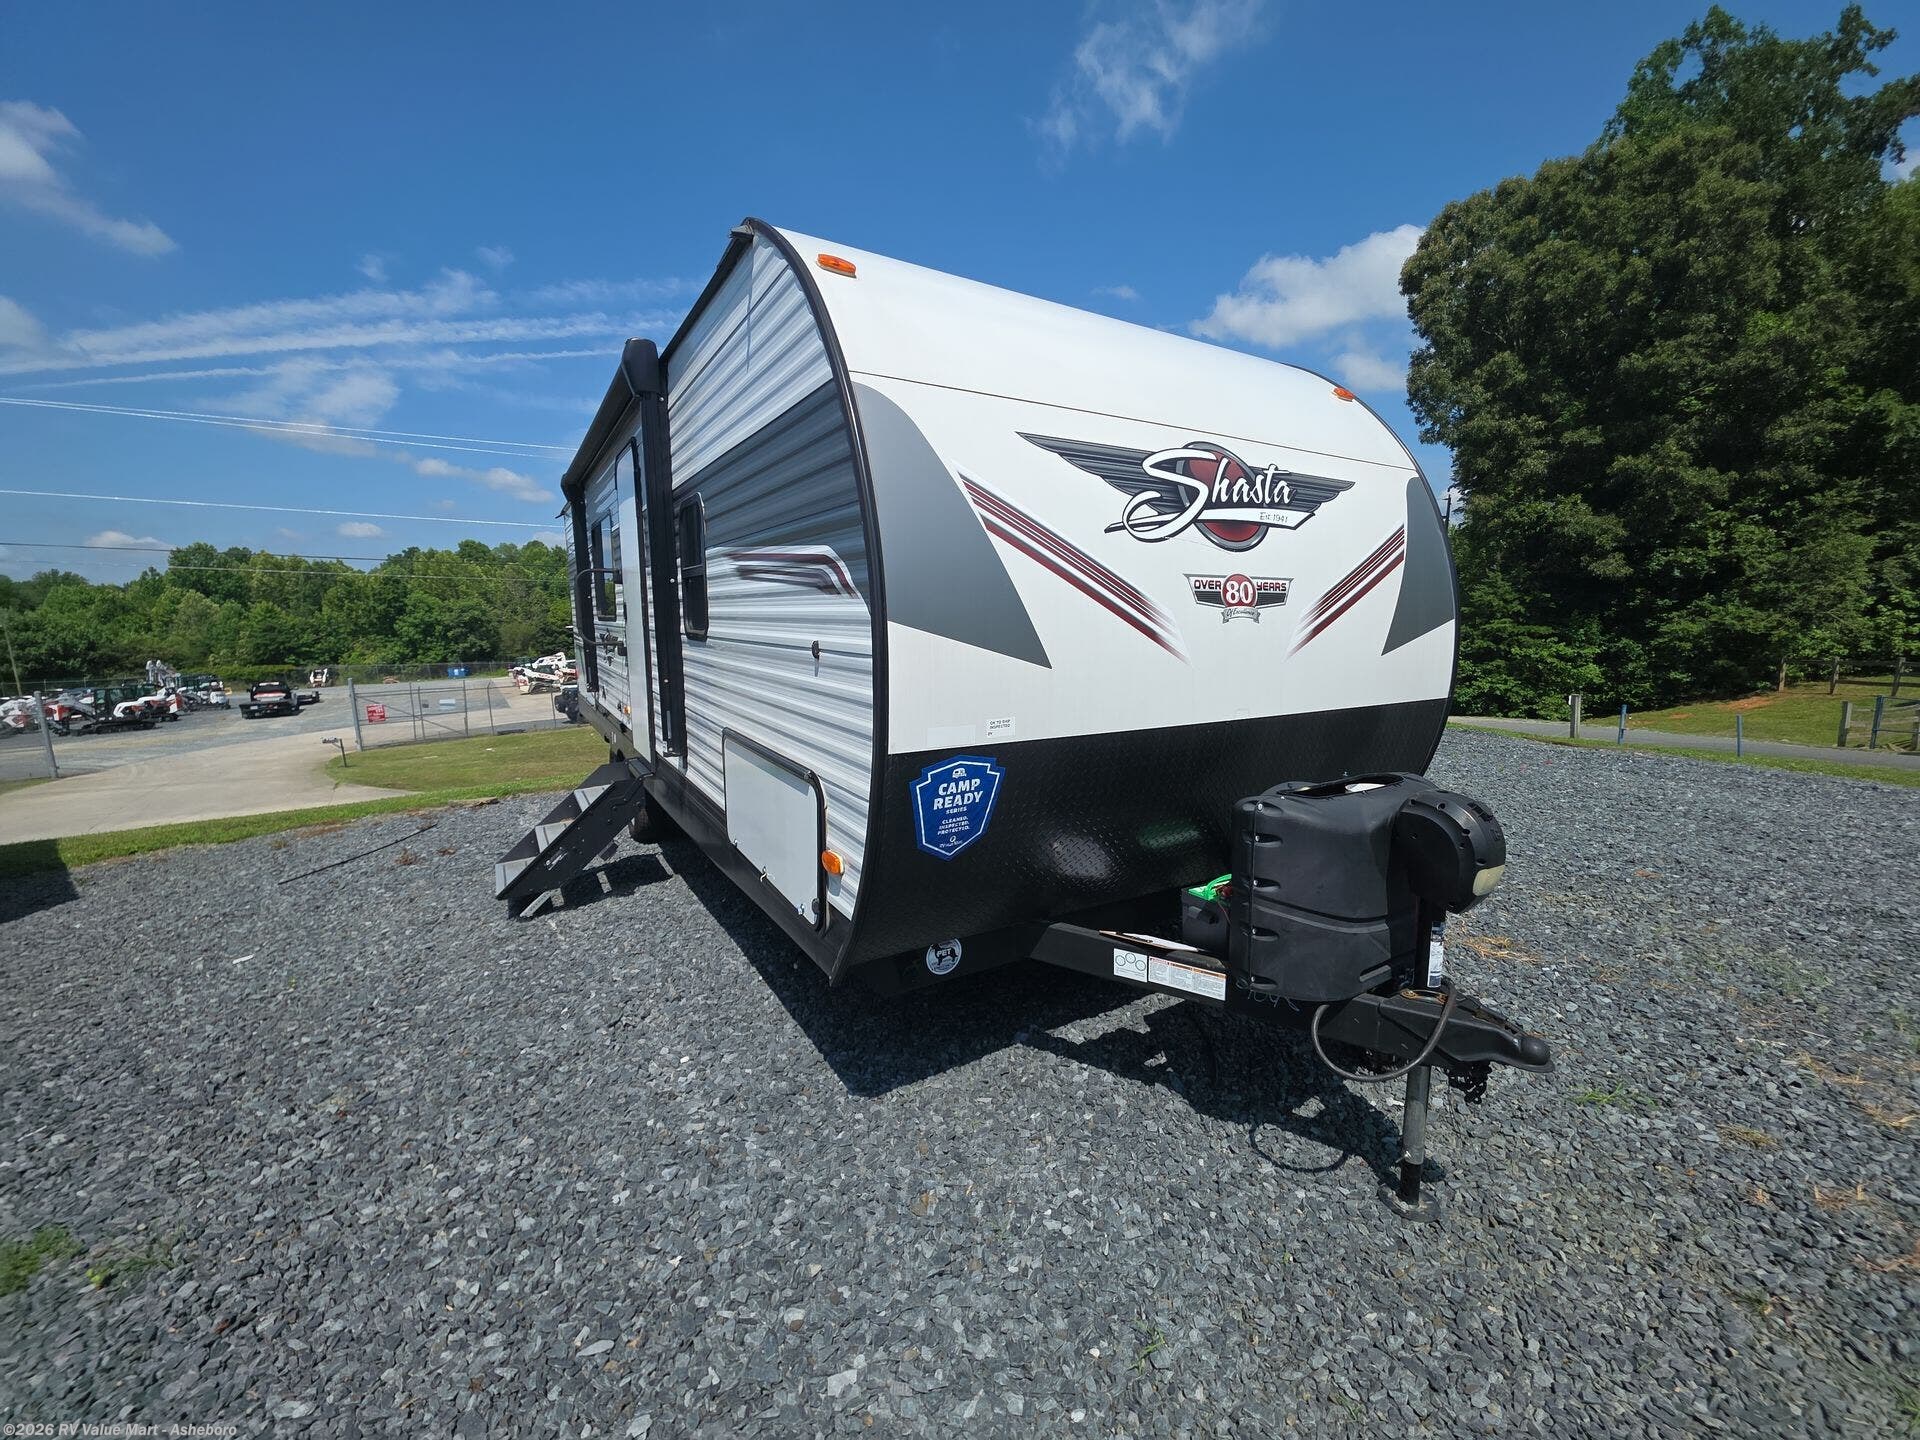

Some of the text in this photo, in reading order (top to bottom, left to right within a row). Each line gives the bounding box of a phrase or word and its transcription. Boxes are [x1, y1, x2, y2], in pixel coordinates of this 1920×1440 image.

[1121, 447, 1295, 543] Shasta
[1193, 579, 1287, 604] OVER 80 YEARS
[938, 778, 981, 796] CAMP
[933, 790, 984, 810] READY
[945, 806, 968, 815] SERIES
[936, 948, 952, 957] PET
